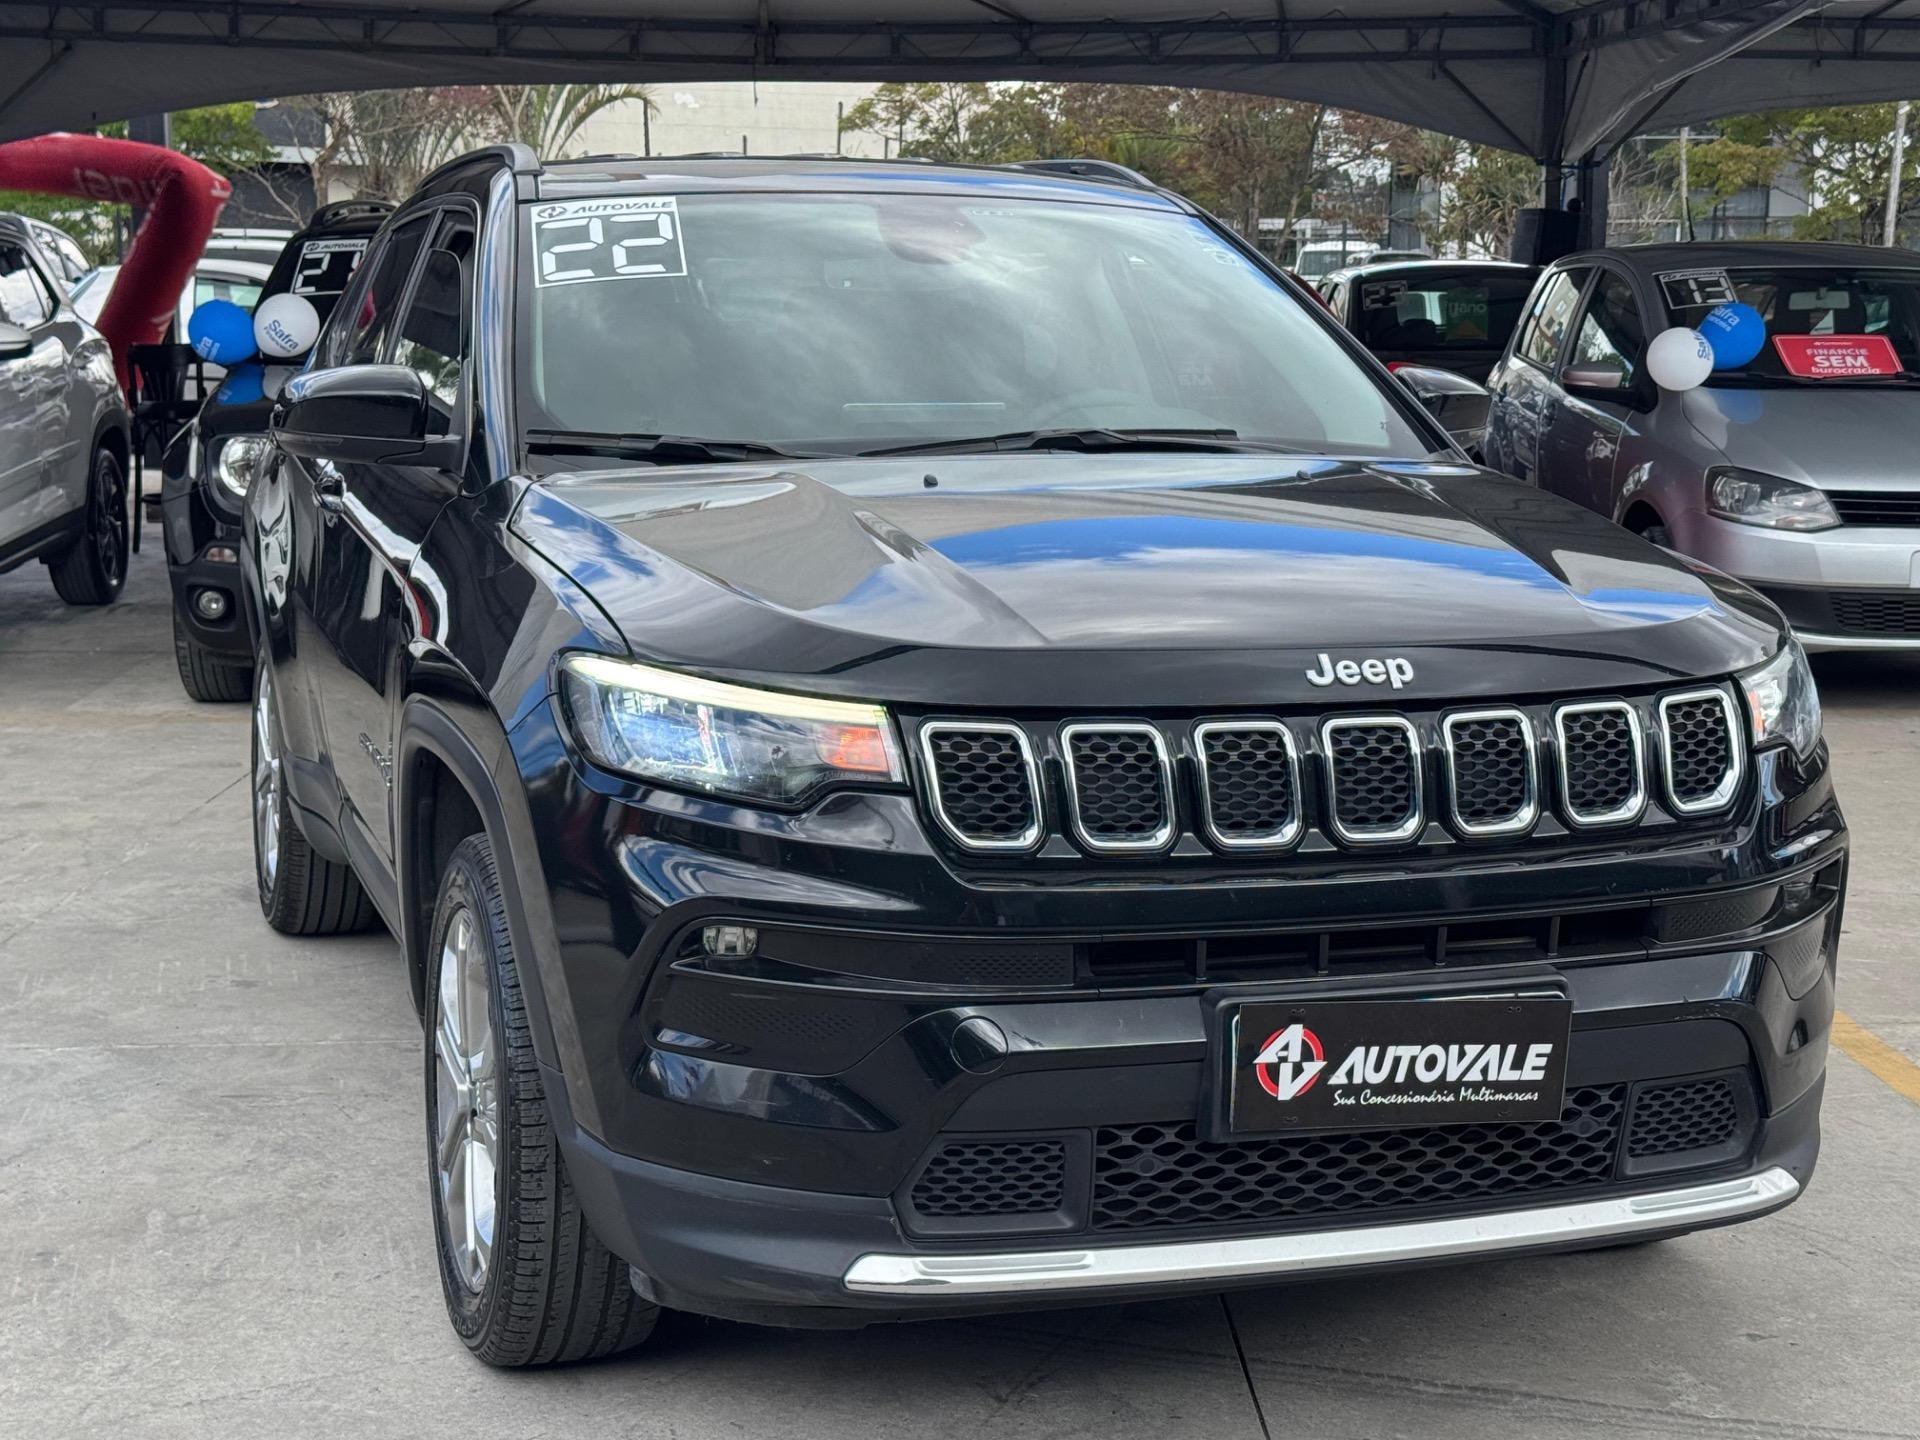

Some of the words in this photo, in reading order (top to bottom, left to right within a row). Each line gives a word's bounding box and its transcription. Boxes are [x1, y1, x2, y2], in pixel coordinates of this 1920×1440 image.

[573, 201, 673, 214] AUTOVALE
[541, 213, 673, 281] 22
[268, 319, 299, 350] Safra
[1806, 348, 1869, 356] FINANCIE
[1815, 356, 1869, 368] SEM
[1811, 367, 1880, 375] burocracia
[1305, 653, 1414, 689] Jeep
[1327, 1043, 1553, 1085] AUTOVALE
[1333, 1090, 1356, 1106] Sua
[1360, 1089, 1455, 1105] Concessionária
[1459, 1086, 1539, 1102] Multimarcas
